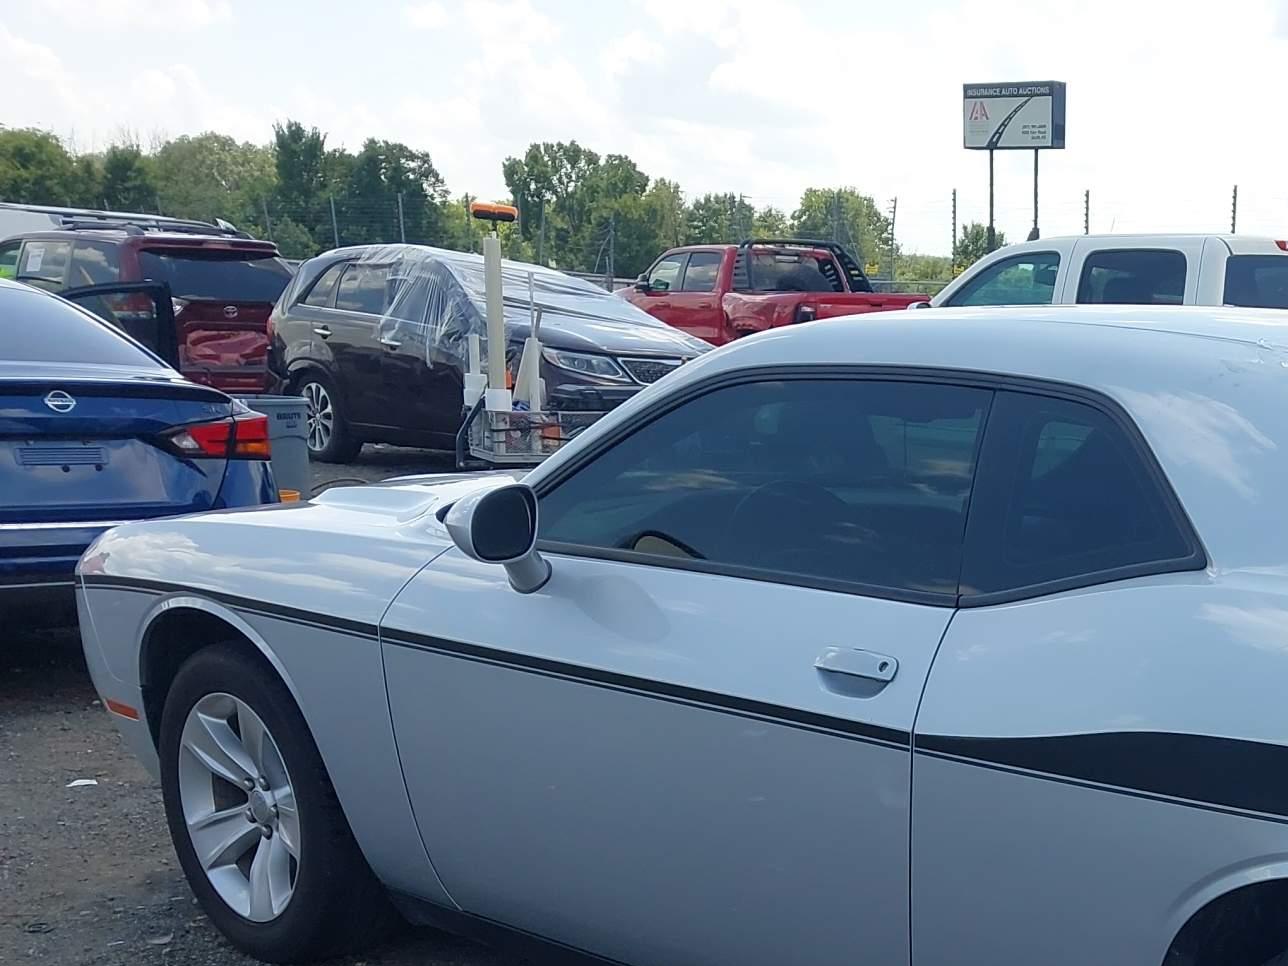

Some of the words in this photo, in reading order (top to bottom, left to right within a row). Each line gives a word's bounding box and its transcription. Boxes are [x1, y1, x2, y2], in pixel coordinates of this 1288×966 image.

[966, 87, 1001, 97] INSURANCE
[1002, 86, 1018, 95] AUTO
[1019, 86, 1050, 94] AUCTIONS
